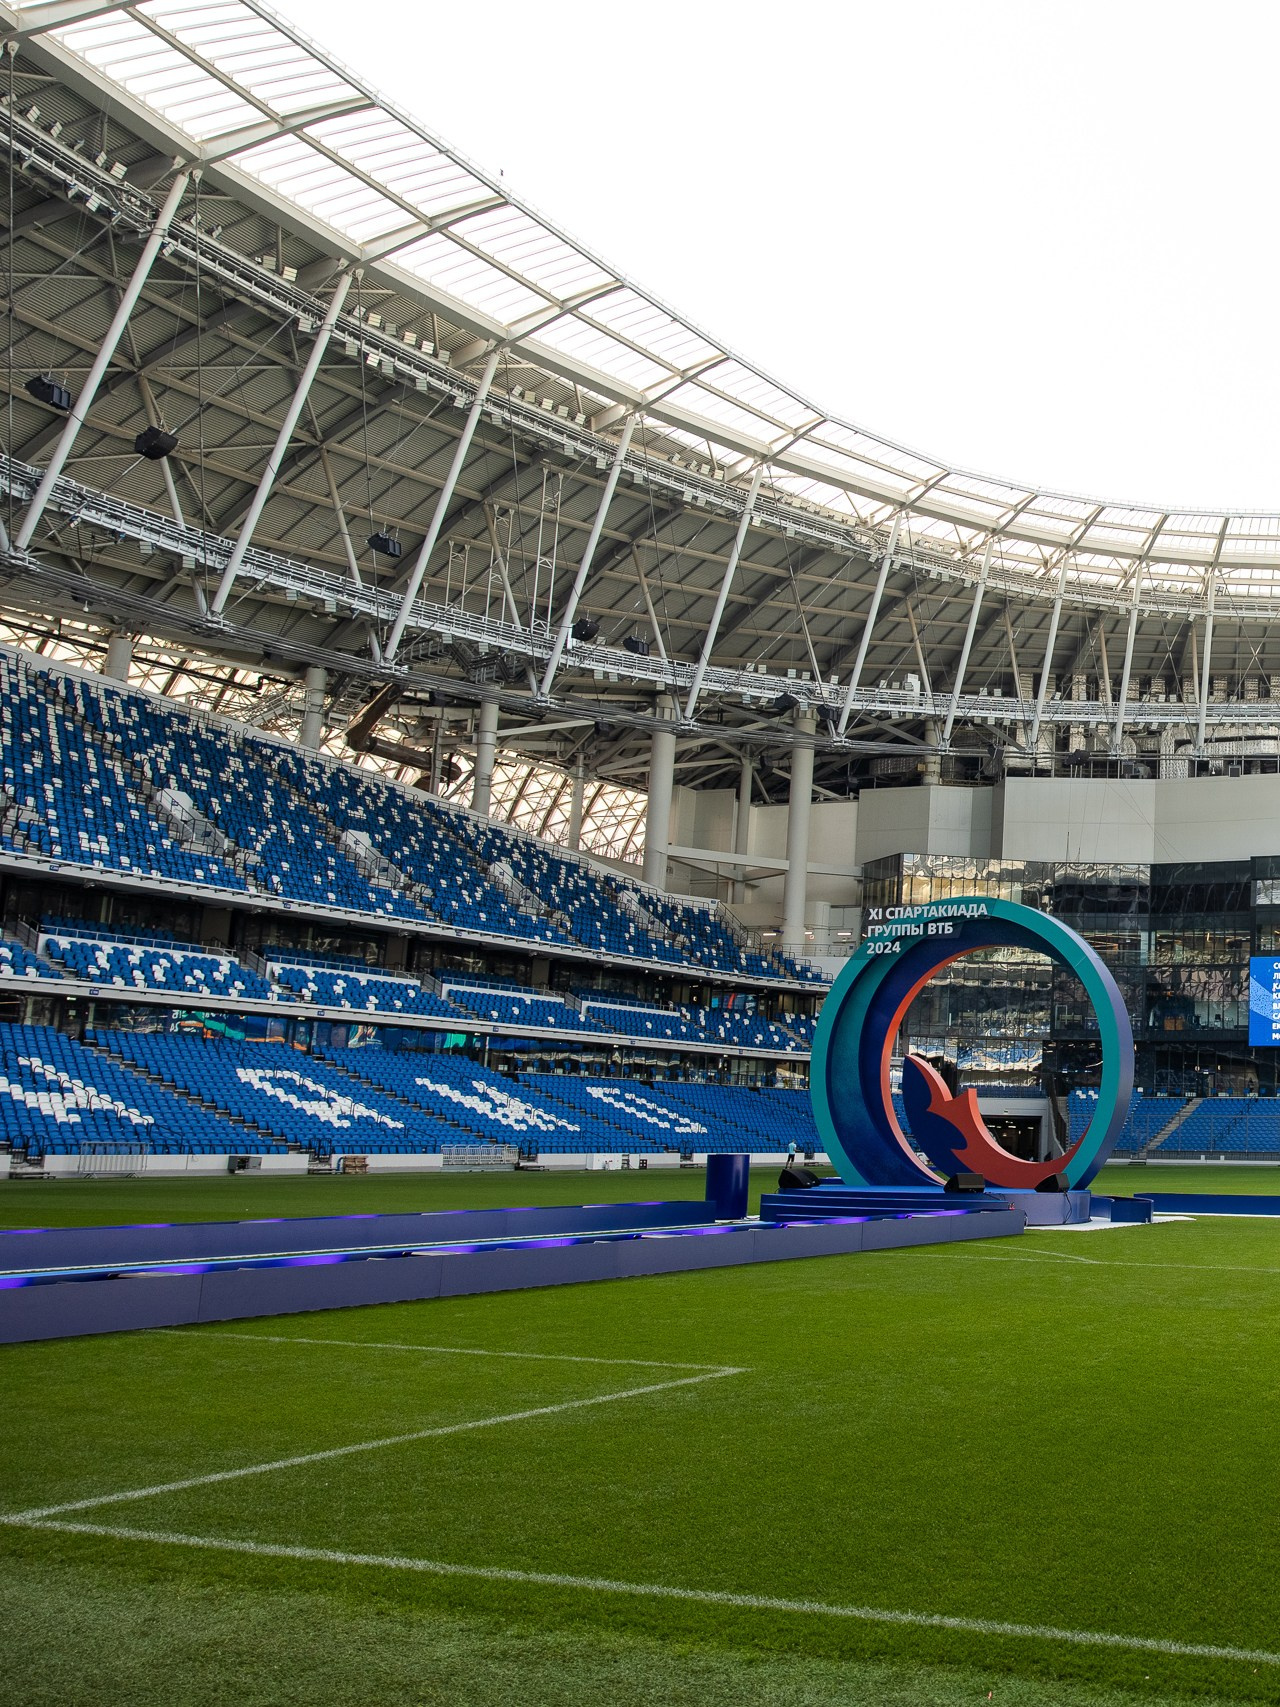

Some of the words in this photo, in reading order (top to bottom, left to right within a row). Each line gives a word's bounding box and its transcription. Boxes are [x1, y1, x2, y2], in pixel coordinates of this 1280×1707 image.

[885, 903, 988, 919] СПАРТАКИАДА
[867, 923, 924, 938] ГРУППЫ
[927, 922, 954, 935] ВТБ
[866, 942, 901, 954] 2024
